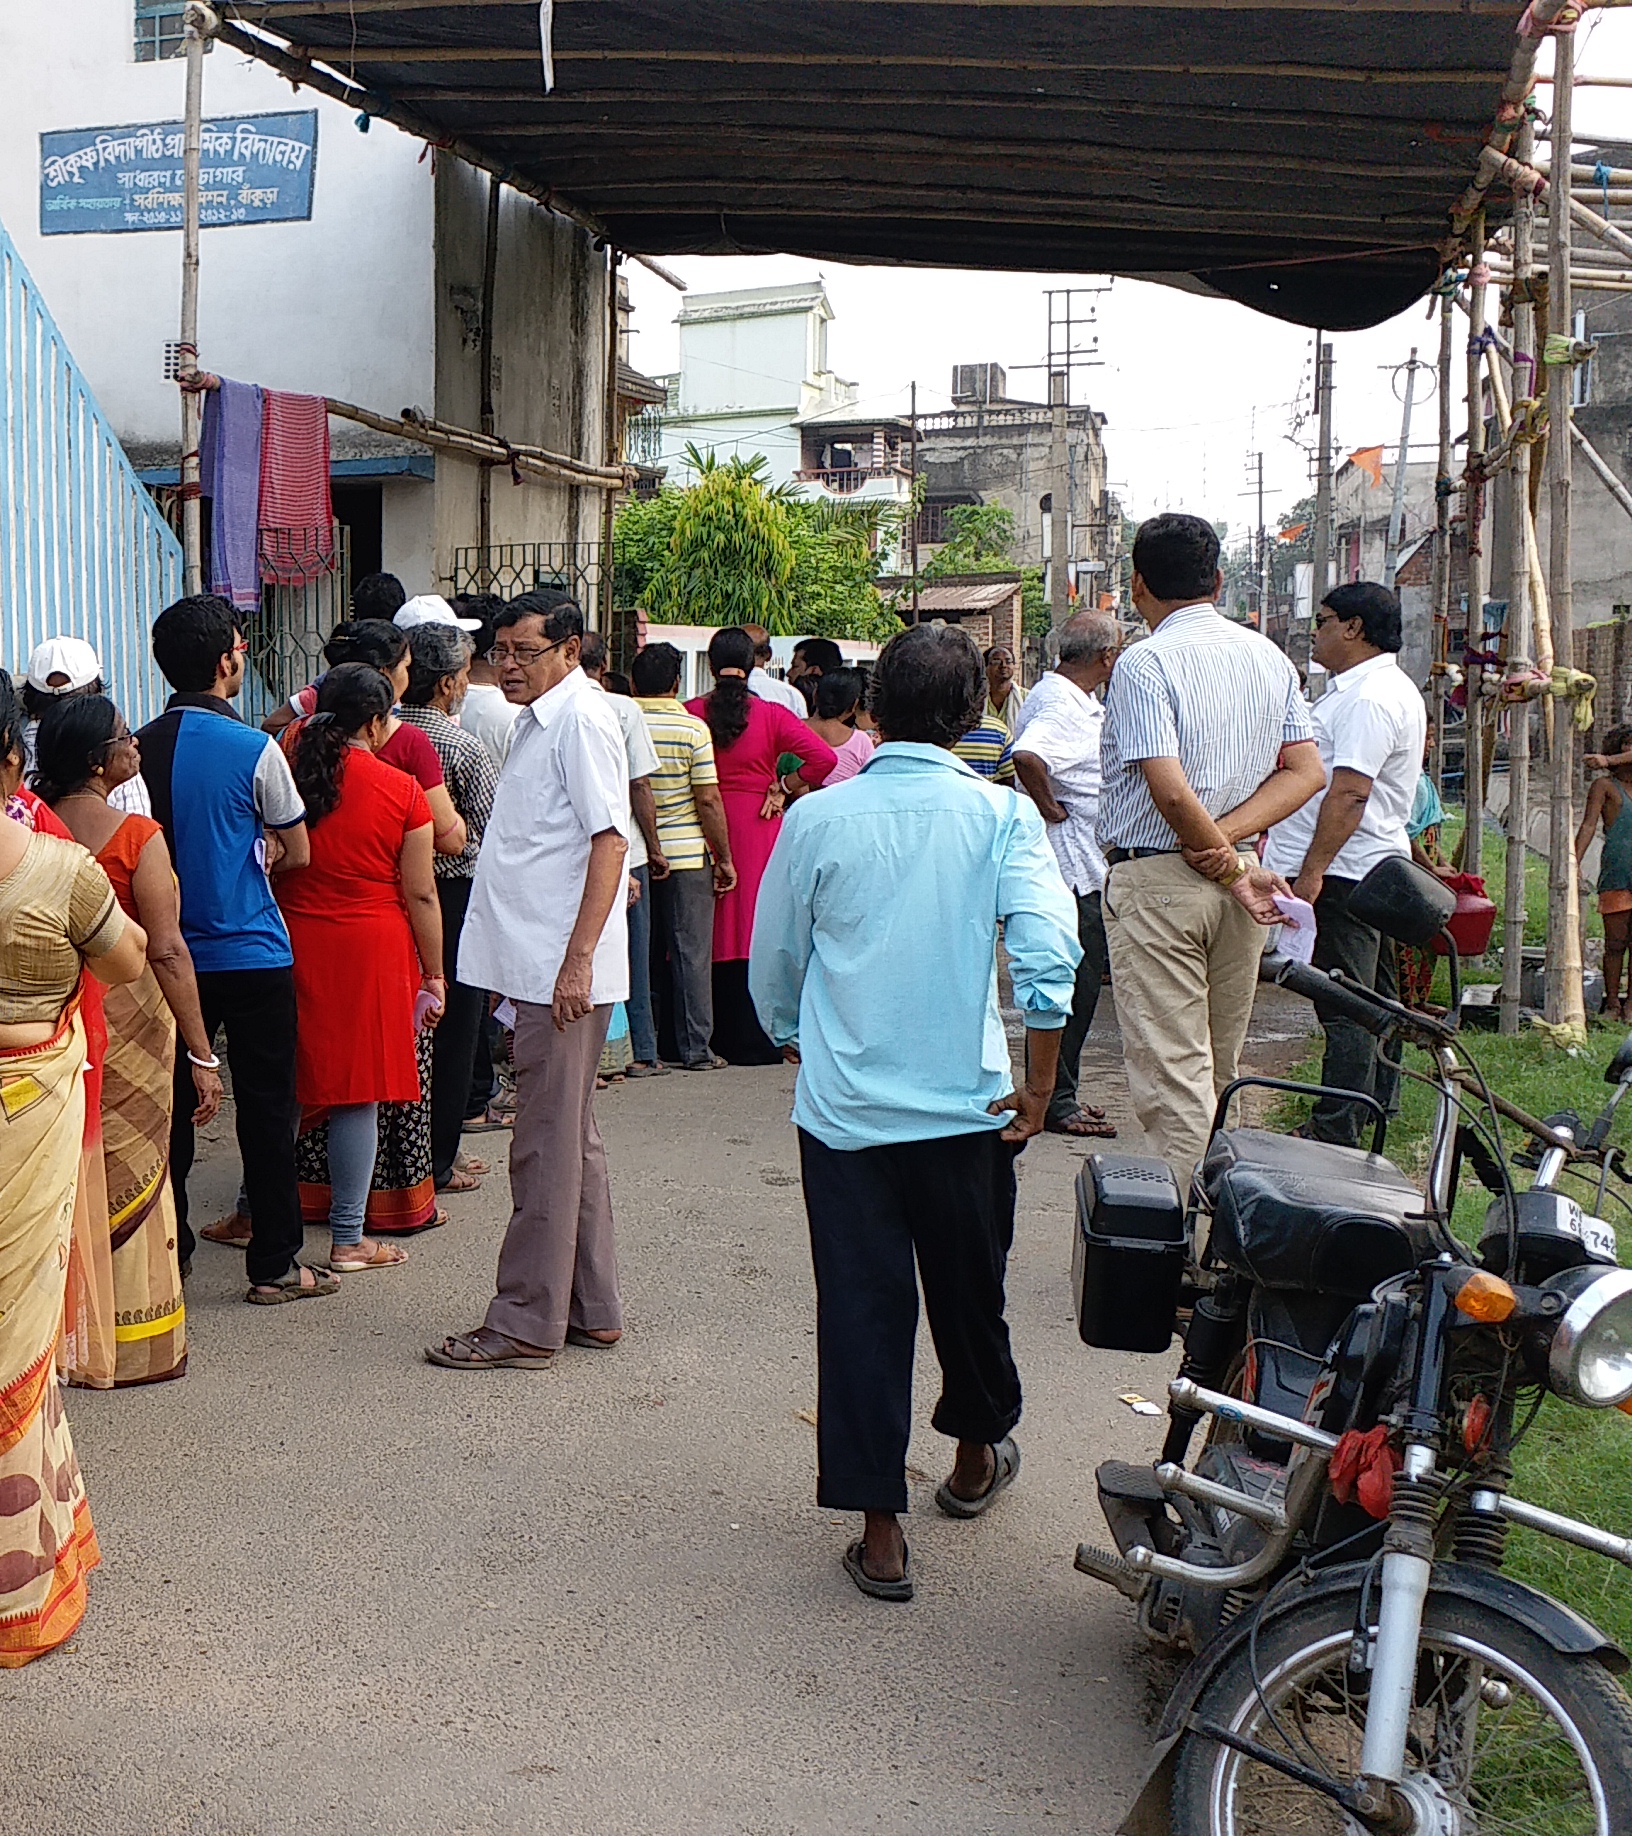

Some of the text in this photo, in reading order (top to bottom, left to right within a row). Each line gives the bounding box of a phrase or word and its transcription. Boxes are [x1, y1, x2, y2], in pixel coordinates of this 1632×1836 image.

[164, 125, 234, 159] প্রামিক
[233, 123, 312, 171] বিদ্যালয়
[116, 169, 173, 189] সাধারণ
[238, 183, 280, 208] বাঁকুড়া
